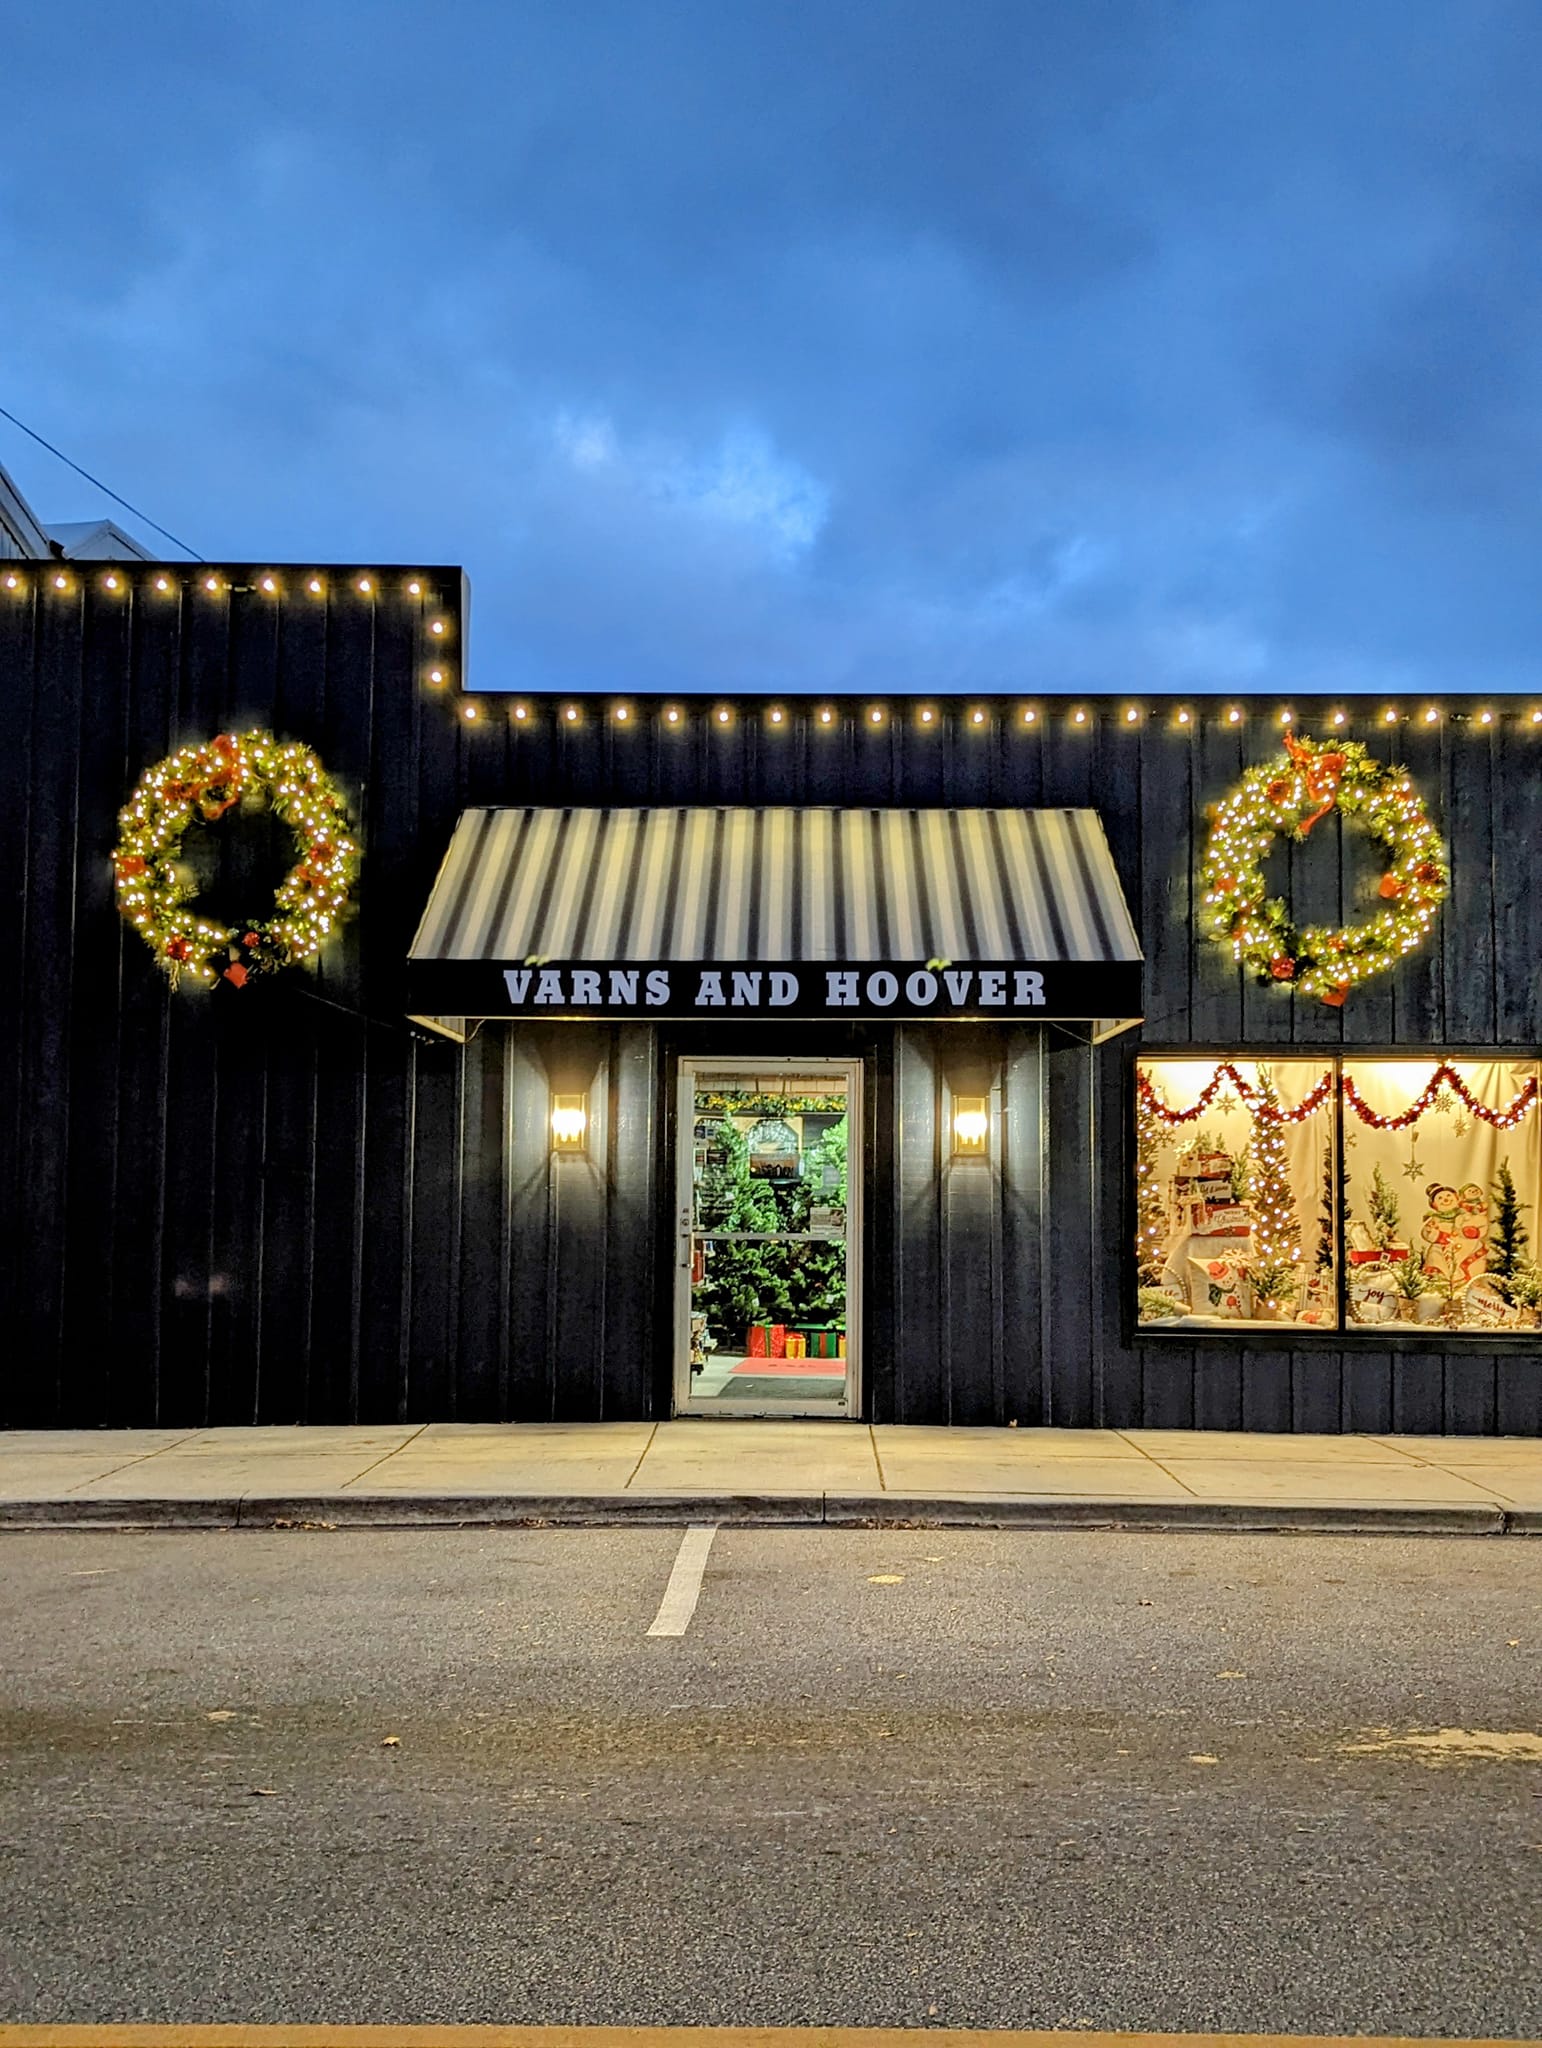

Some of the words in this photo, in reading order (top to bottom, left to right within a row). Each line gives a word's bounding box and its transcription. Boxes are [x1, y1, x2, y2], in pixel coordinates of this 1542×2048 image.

[503, 969, 671, 1006] VARNS
[695, 971, 799, 1006] AND
[825, 970, 1046, 1006] HOOVER
